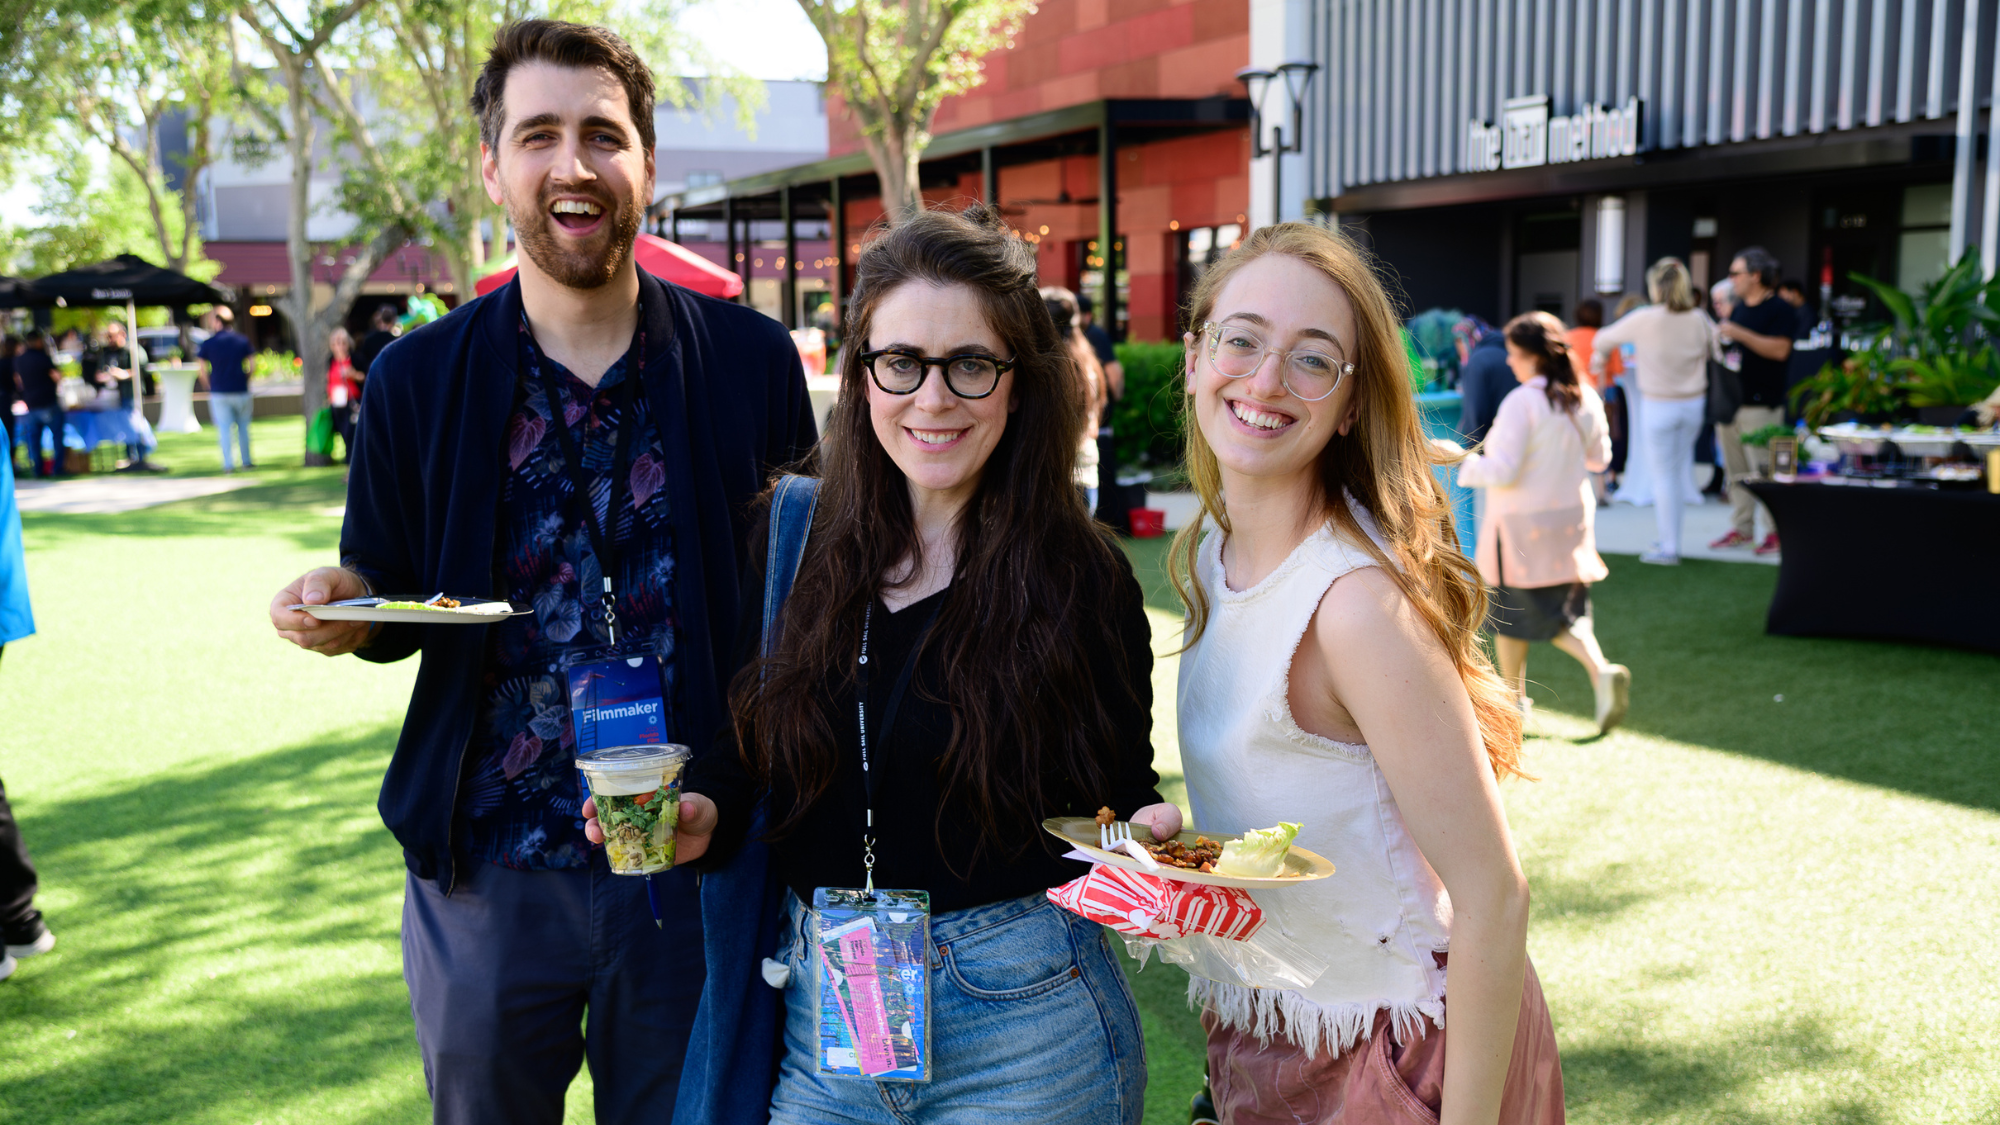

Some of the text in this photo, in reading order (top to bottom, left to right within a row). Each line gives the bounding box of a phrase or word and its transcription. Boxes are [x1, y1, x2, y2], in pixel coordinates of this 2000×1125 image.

[1549, 95, 1638, 164] method
[583, 702, 658, 723] Filmmaker
[869, 979, 879, 1003] Ticket
[875, 1003, 886, 1036] Voucher.
